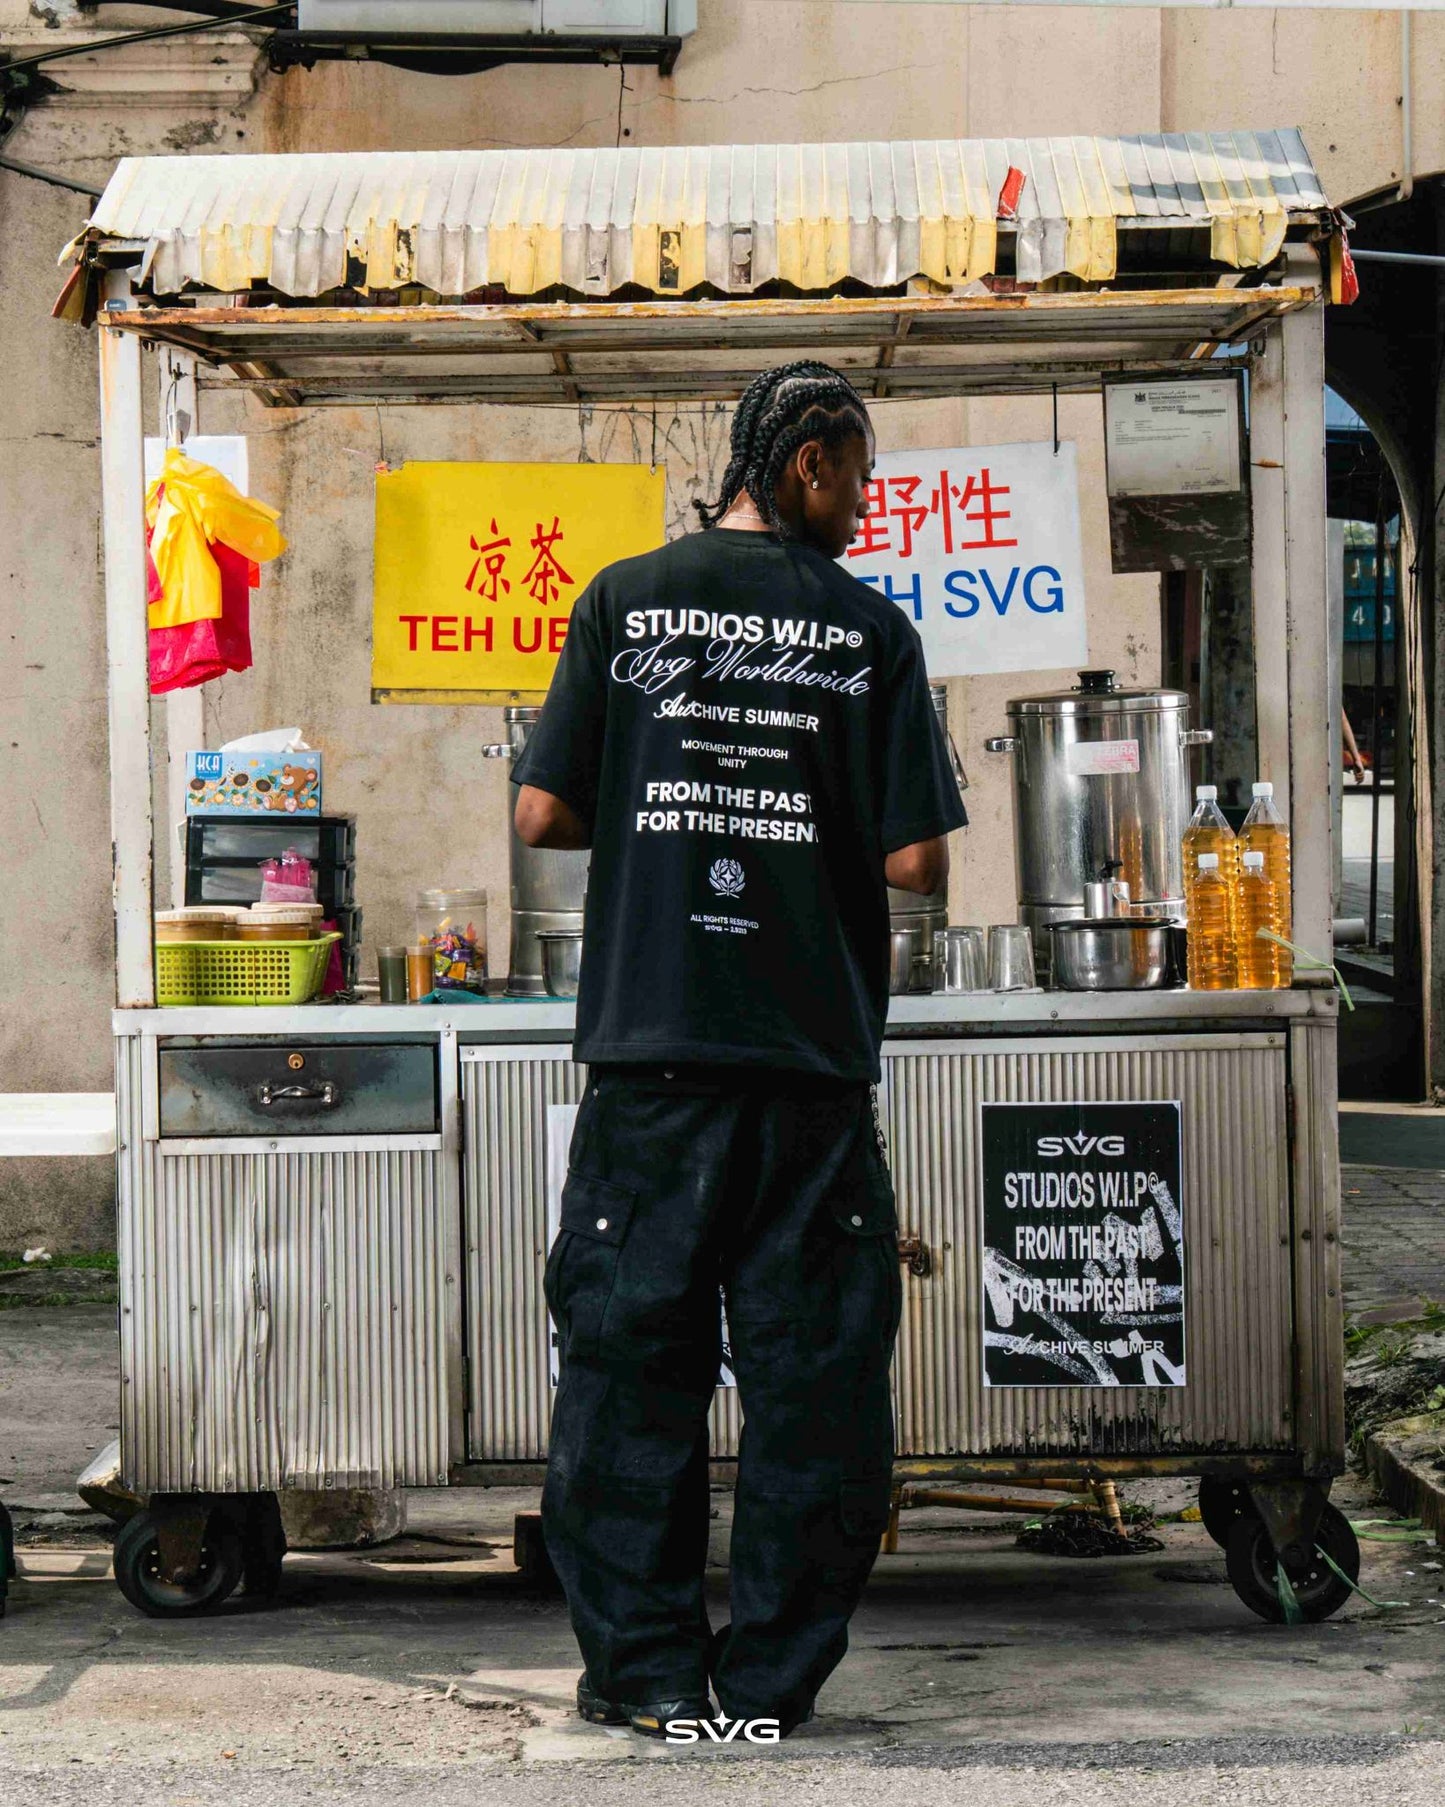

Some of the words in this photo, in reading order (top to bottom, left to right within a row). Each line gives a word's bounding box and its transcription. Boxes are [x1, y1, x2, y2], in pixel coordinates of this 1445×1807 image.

[847, 468, 1018, 558] 野性
[464, 516, 575, 606] 凉茶
[944, 565, 1064, 619] SVG
[399, 615, 493, 652] TEH
[625, 608, 764, 643] STUDIOS
[702, 633, 872, 696] Worldwide
[745, 709, 819, 733] SUMMER
[681, 739, 735, 755] MOVEMENT
[738, 746, 788, 760] THROUGH
[718, 756, 747, 769] UNITY
[646, 781, 711, 803] FROM
[715, 785, 754, 809] THE
[636, 810, 680, 832] FOR
[684, 810, 725, 834] THE
[690, 914, 702, 922] ALL
[703, 915, 728, 924] RIGHTS
[729, 917, 759, 929] RESERVED
[1036, 1132, 1126, 1157] SVG
[1004, 1172, 1095, 1209] STUDIOS
[1015, 1226, 1066, 1260] FROM
[1068, 1226, 1101, 1260] THE
[1104, 1226, 1149, 1260] PAST
[1047, 1278, 1080, 1312] THE
[1083, 1277, 1157, 1312] PRESENT
